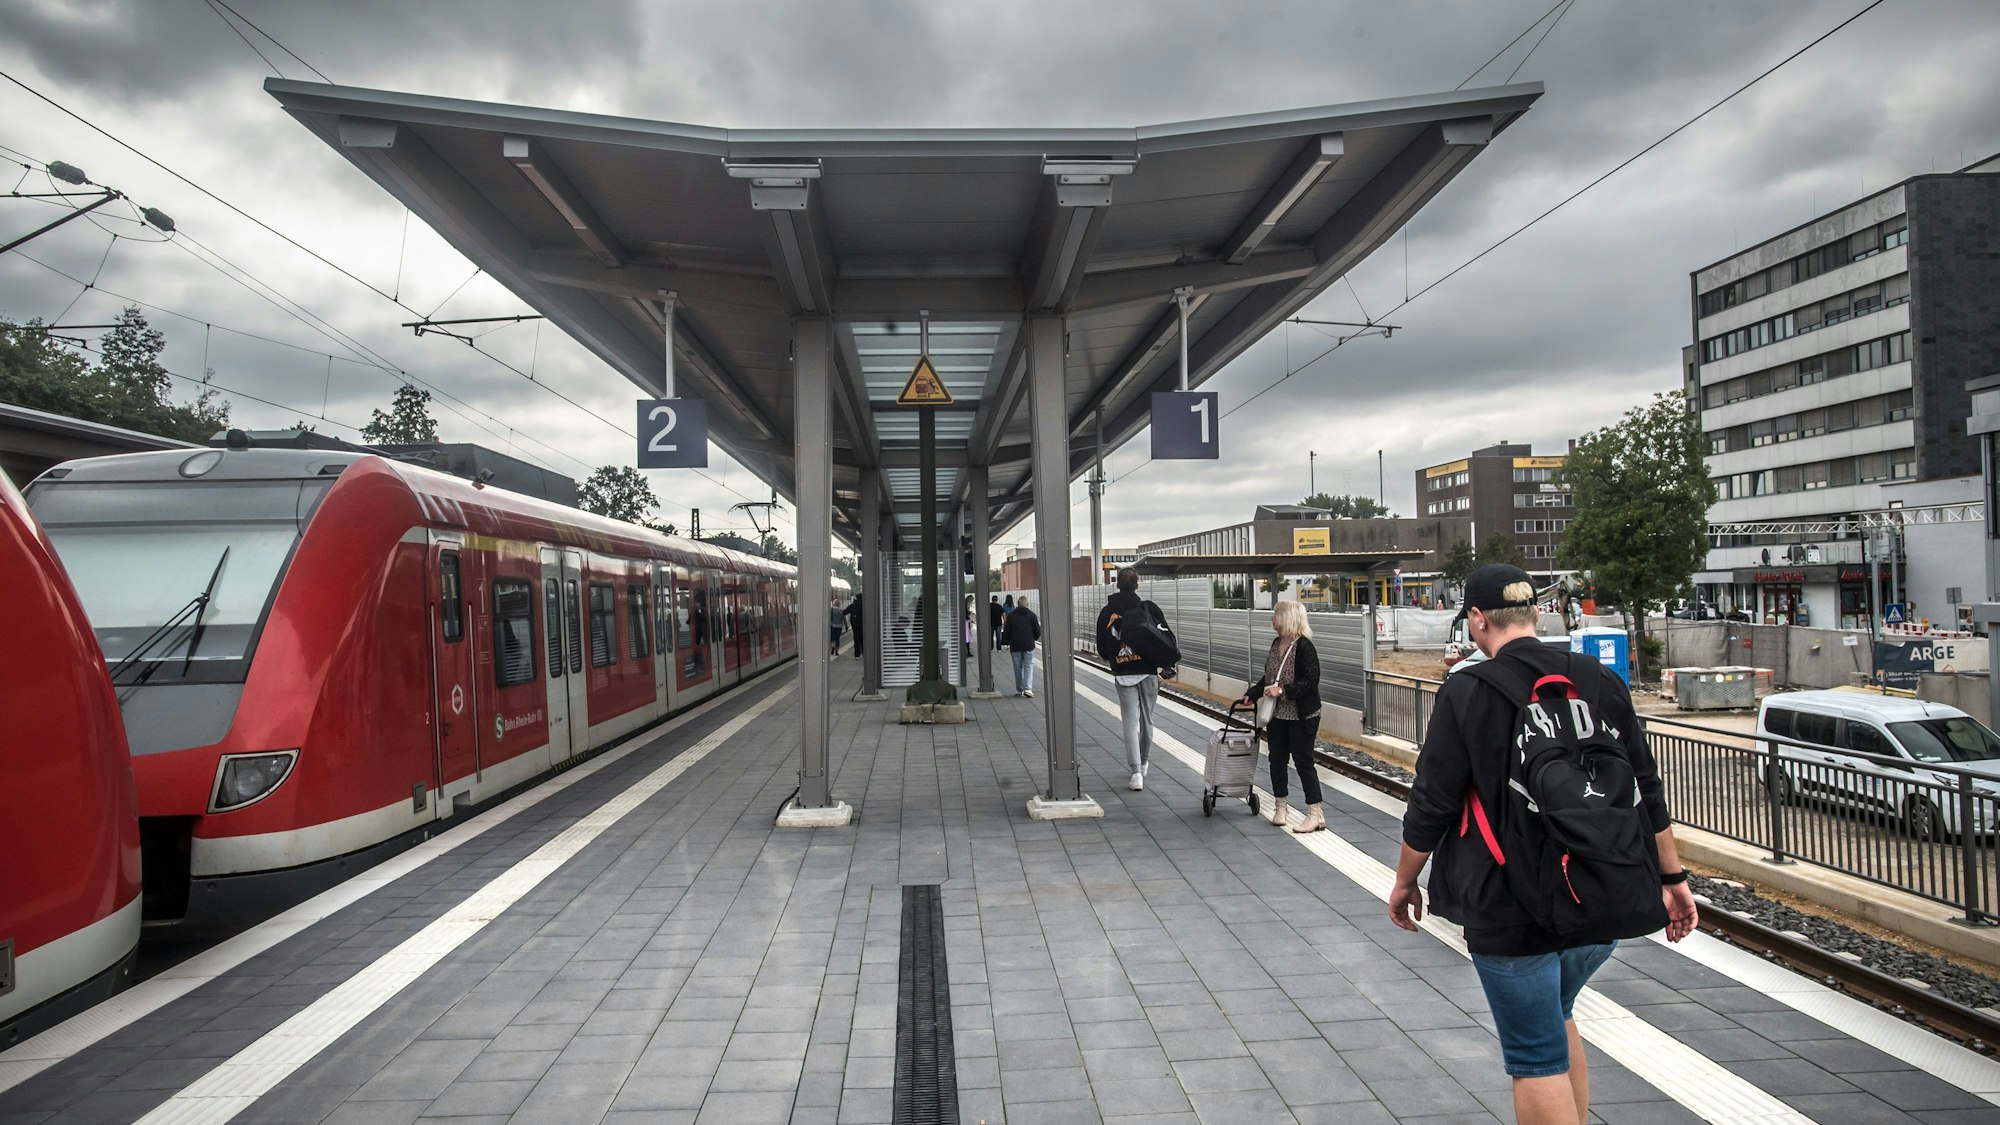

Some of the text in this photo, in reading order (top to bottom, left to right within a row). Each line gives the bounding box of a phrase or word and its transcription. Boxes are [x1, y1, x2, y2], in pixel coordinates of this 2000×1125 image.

[648, 406, 677, 452] 2
[1190, 398, 1210, 443] 1
[1909, 645, 1956, 661] ARGE
